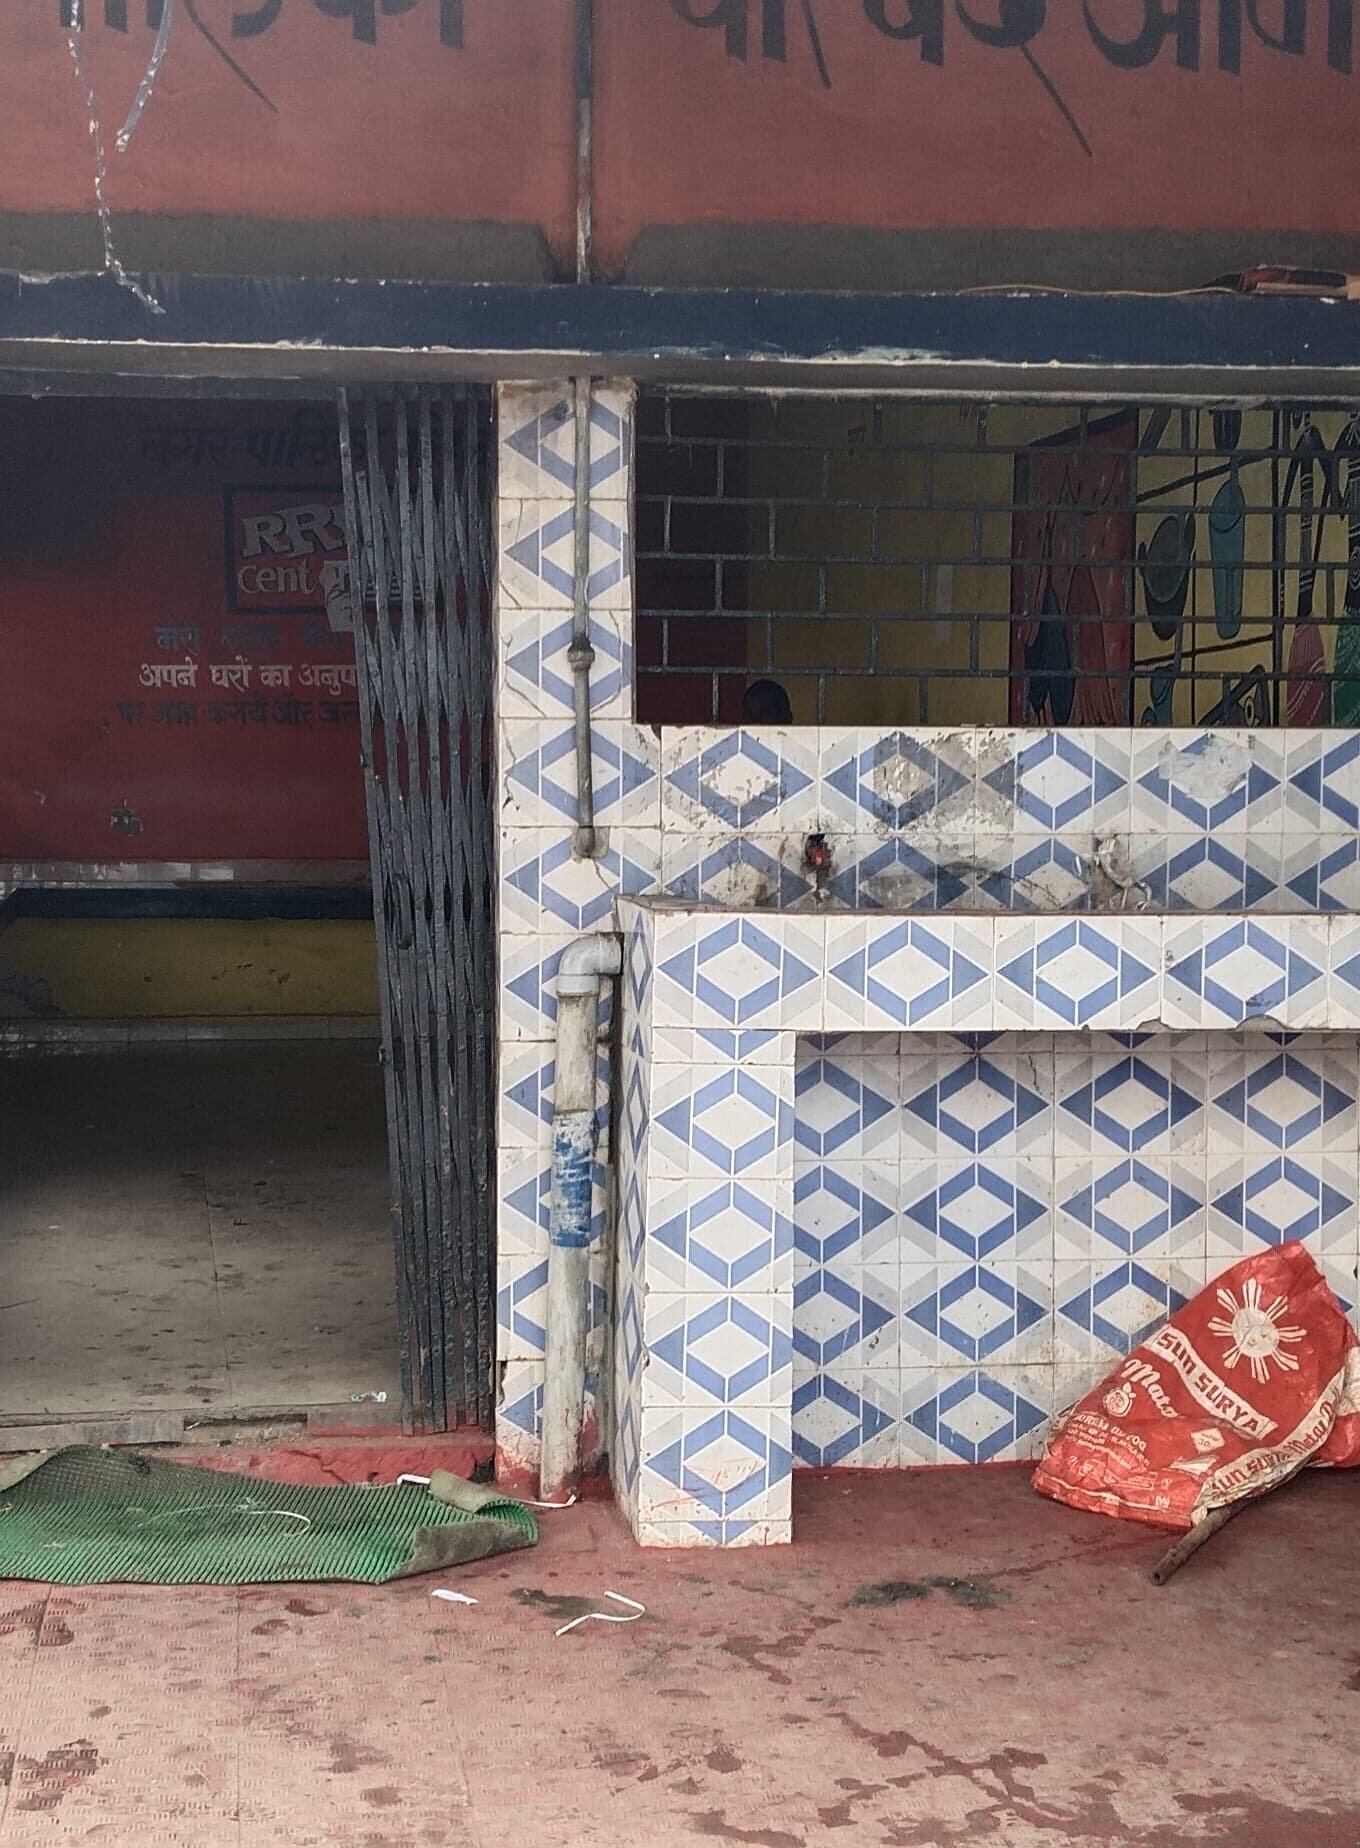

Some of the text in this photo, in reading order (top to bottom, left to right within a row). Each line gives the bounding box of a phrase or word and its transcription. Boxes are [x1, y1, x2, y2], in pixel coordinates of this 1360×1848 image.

[238, 558, 318, 594] Cent
[139, 655, 359, 696] अपने घरों का अनुप
[1195, 1372, 1259, 1432] SURYA
